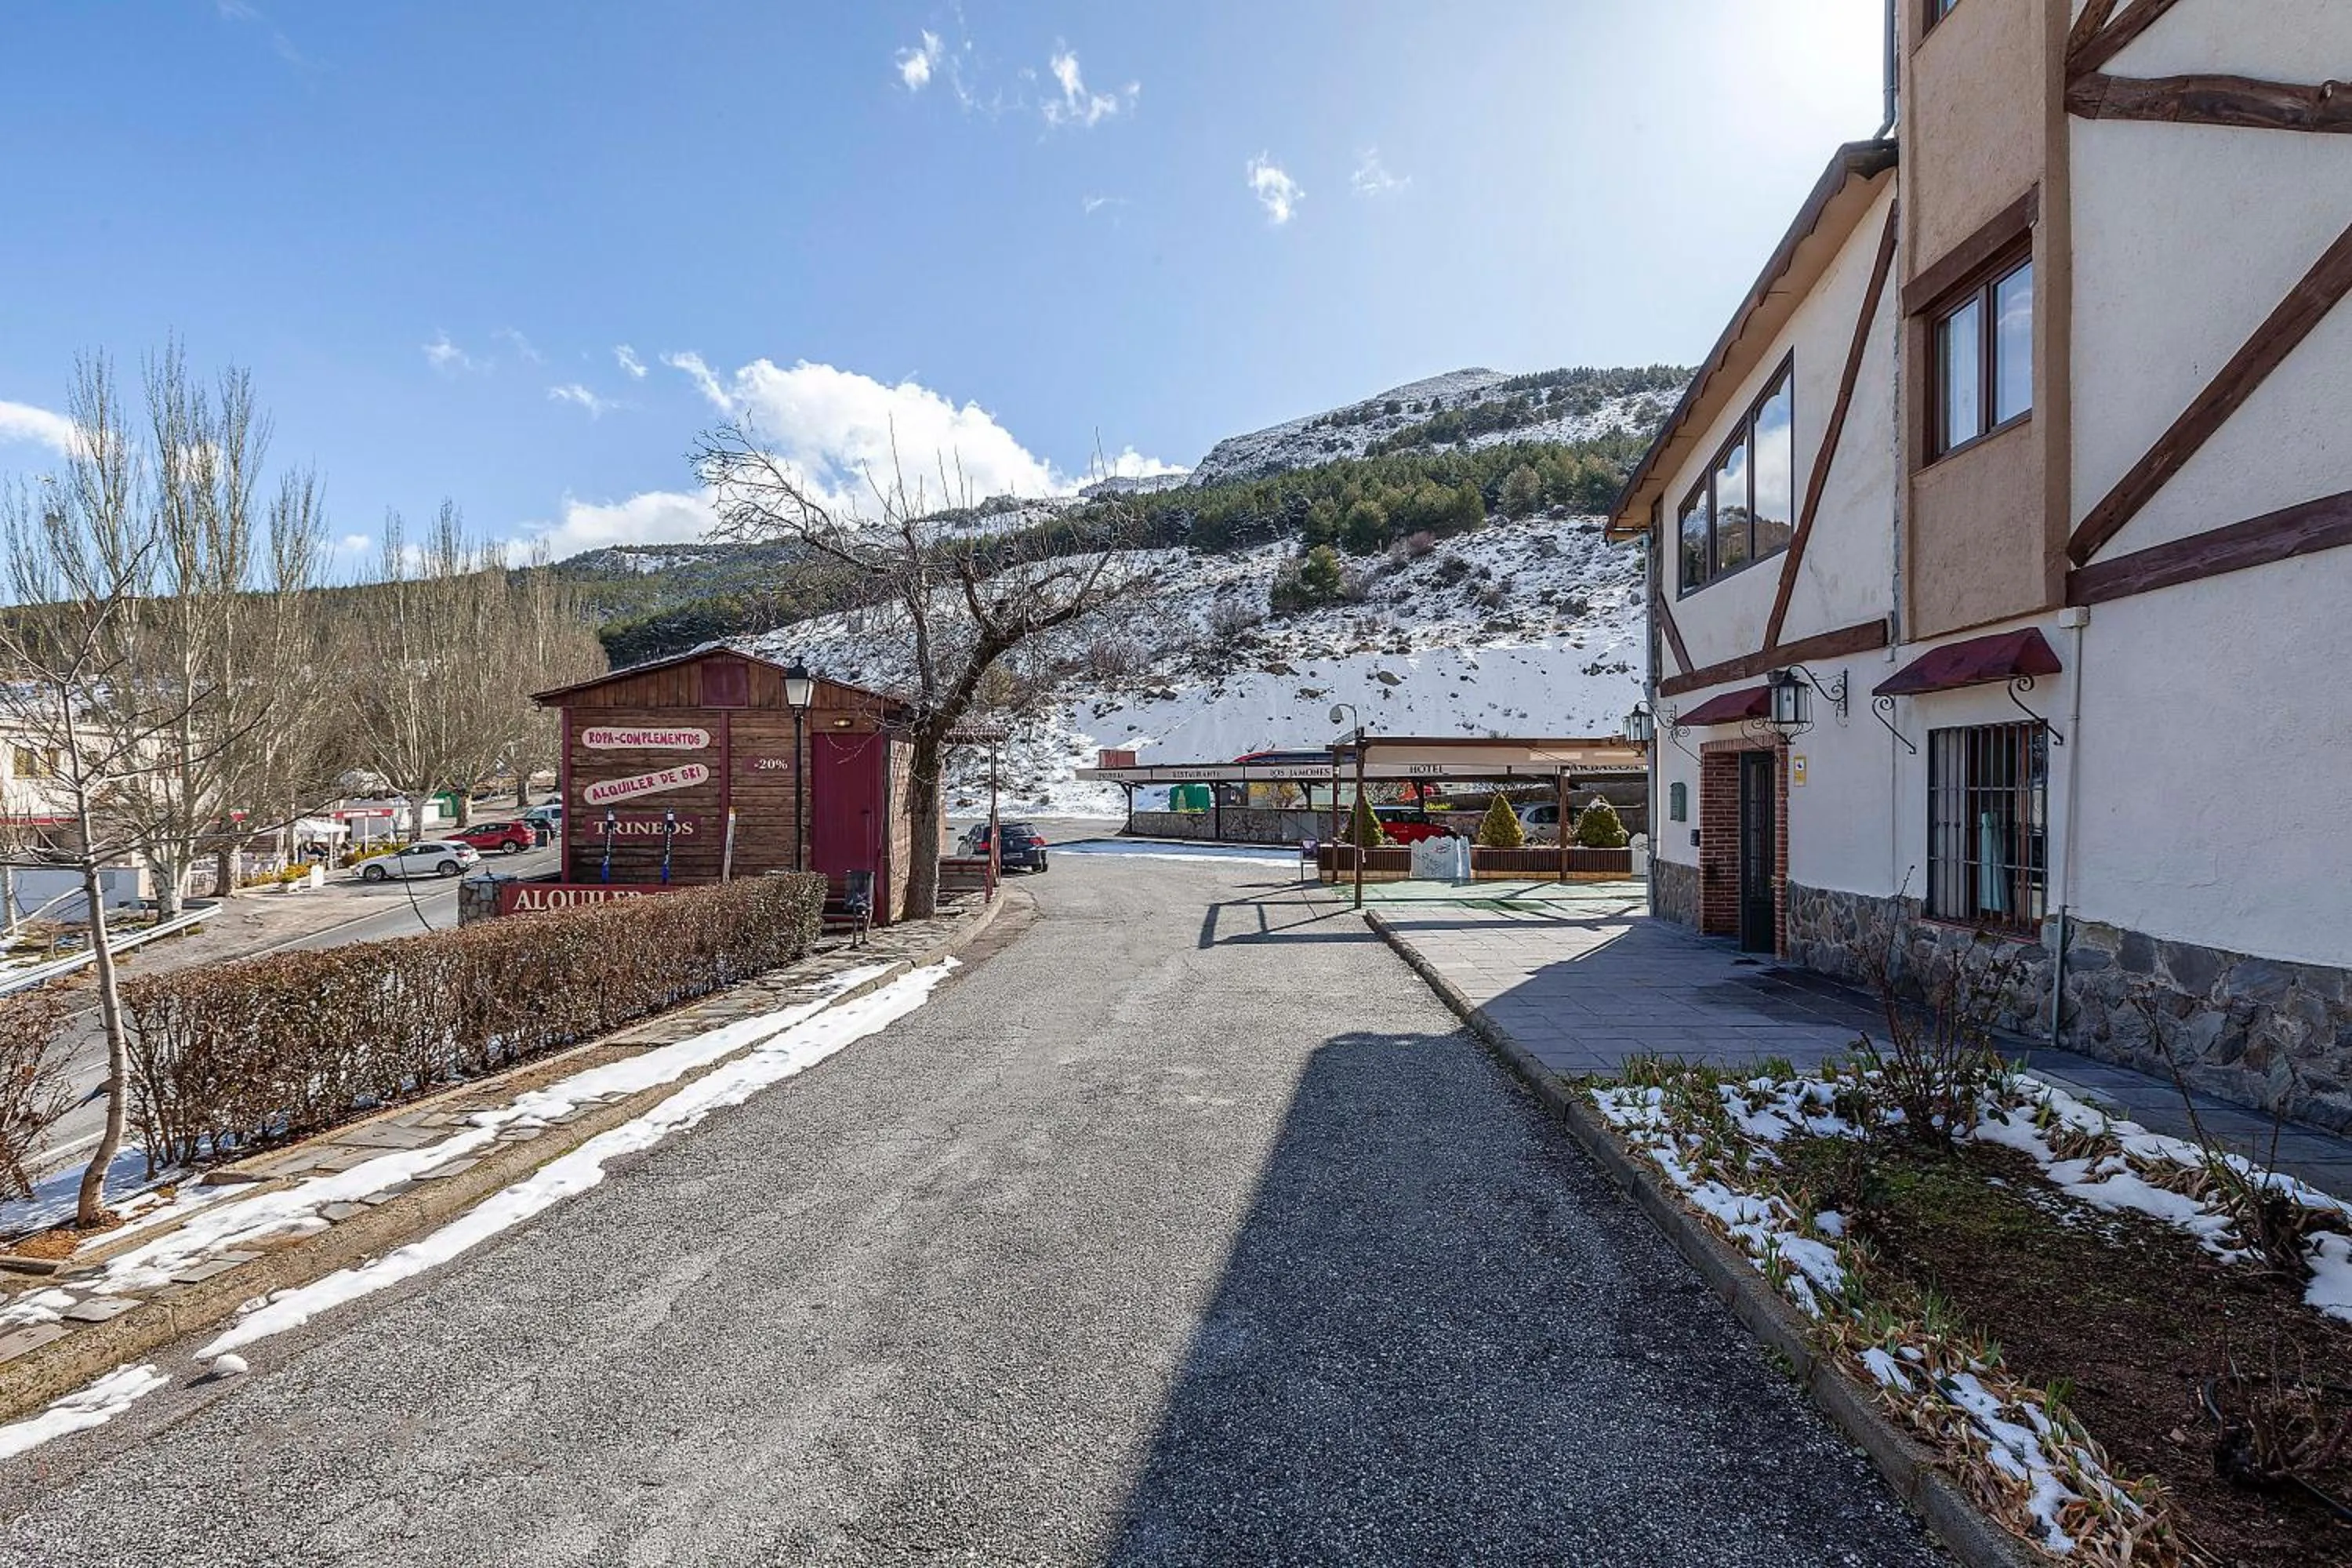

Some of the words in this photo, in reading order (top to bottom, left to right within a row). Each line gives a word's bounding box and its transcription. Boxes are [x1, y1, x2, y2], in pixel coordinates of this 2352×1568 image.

[589, 731, 700, 745] ROPA-COMPLEMENTOS
[754, 758, 788, 769] -20%
[1409, 765, 1444, 774] HOTEL
[592, 775, 655, 800] ALQUILER
[659, 771, 677, 784] DE
[593, 821, 694, 835] TRINEOS
